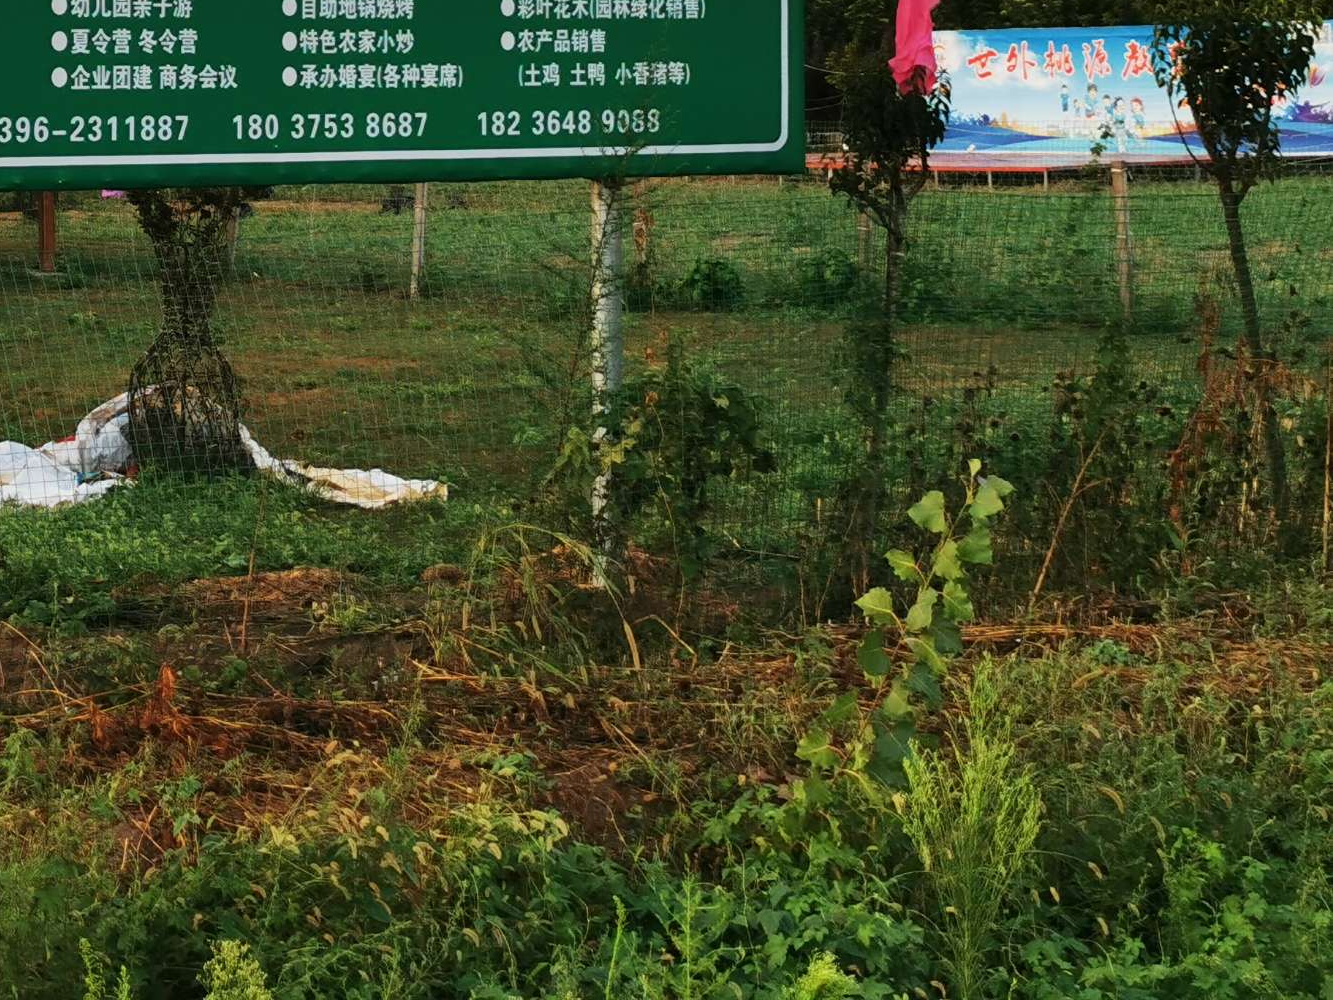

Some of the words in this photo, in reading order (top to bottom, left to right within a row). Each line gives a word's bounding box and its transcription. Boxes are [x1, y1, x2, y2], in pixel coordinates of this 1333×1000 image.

[70, 28, 132, 54] 夏令营
[139, 28, 198, 54] 冬令营
[299, 28, 415, 54] 特色农家小炒
[517, 28, 606, 53] 农产品销售
[966, 39, 1186, 81] 世外桃源教
[70, 64, 153, 90] 企业团建
[159, 63, 238, 90] 商务会议
[299, 62, 463, 89] 承办婚宴(各种宴席)
[518, 62, 560, 87] (土鸡
[570, 61, 606, 86] 土鸭
[232, 114, 279, 140] 180
[290, 112, 354, 139] 3753
[366, 112, 427, 138] 8687
[477, 110, 521, 136] 182
[532, 109, 591, 135] 3648
